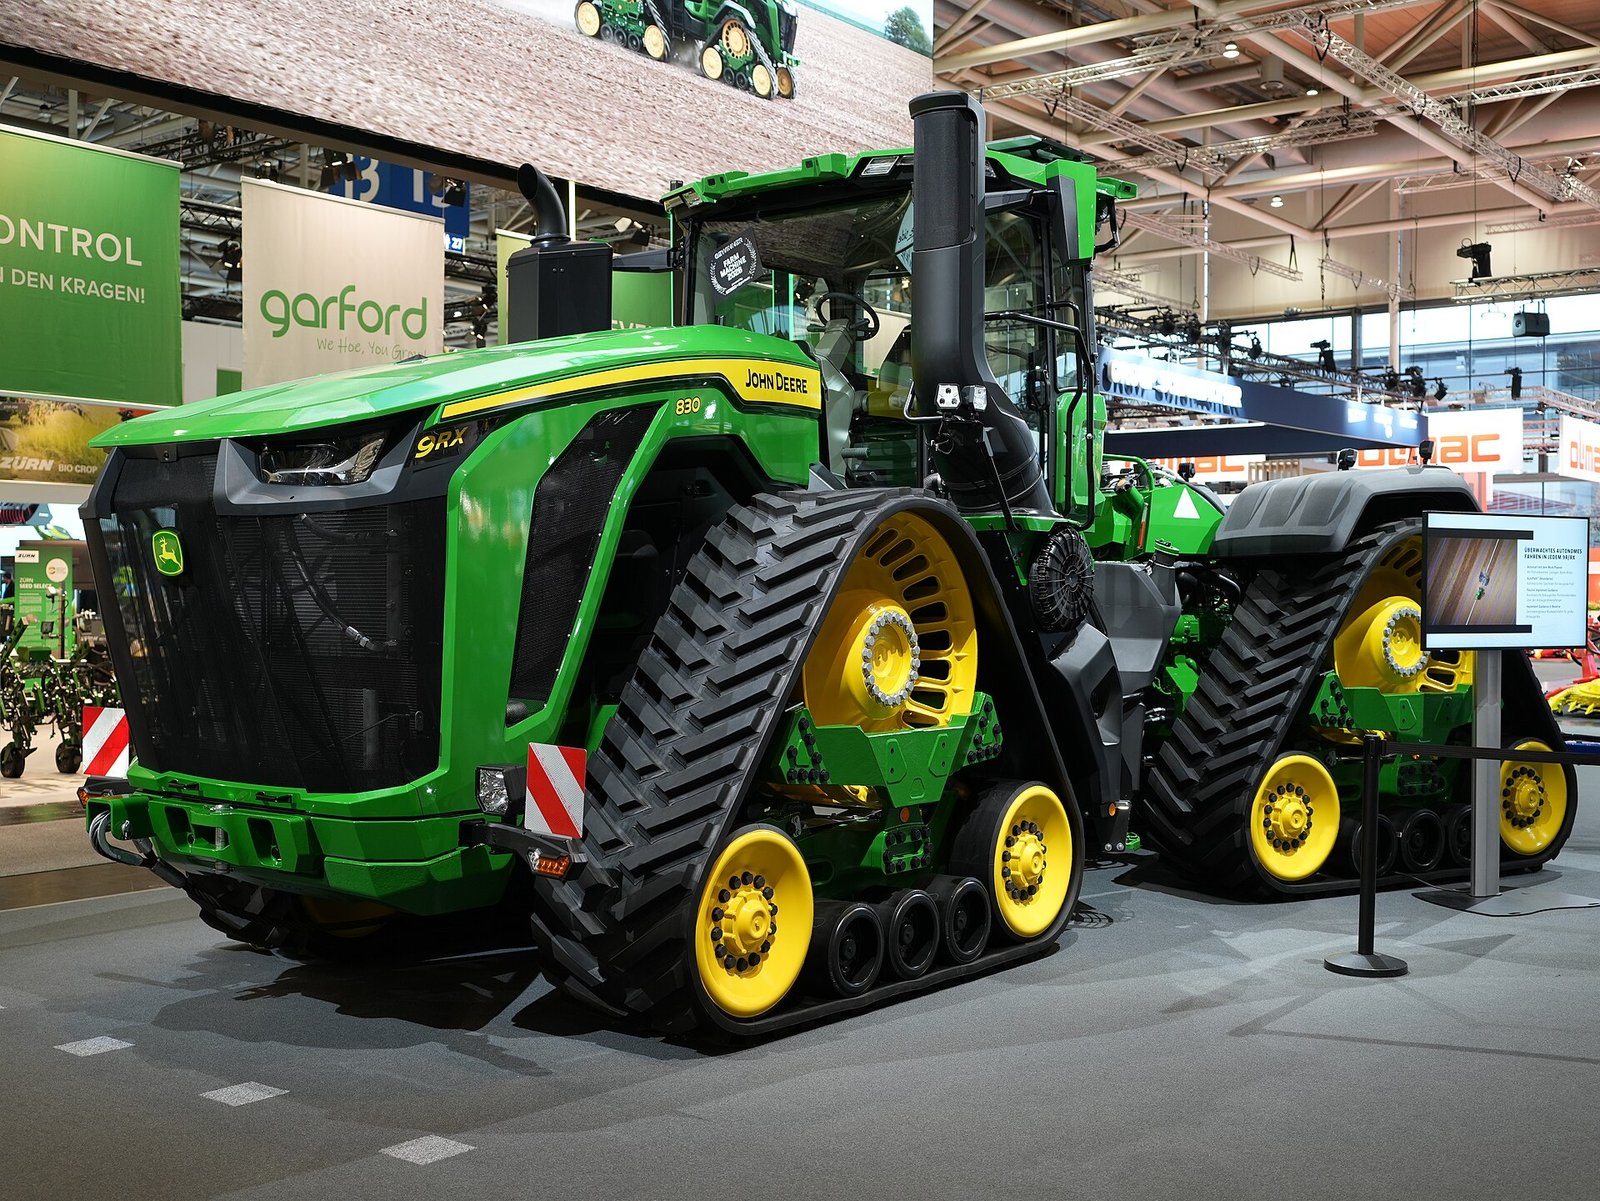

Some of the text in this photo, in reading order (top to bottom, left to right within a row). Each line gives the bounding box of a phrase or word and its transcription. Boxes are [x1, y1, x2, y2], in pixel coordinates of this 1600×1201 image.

[720, 255, 747, 278] MACHINE
[723, 252, 740, 268] FARM
[11, 268, 54, 291] DEN
[60, 275, 146, 304] KRAGEN!
[260, 284, 427, 340] garford
[316, 338, 334, 351] We
[338, 338, 365, 355] Hoe,
[368, 341, 388, 356] You
[745, 368, 808, 394] JOHN DEERE
[675, 396, 701, 416] 830
[414, 426, 469, 459] 9RX
[0, 456, 98, 474] ZÜRN BIO CROP
